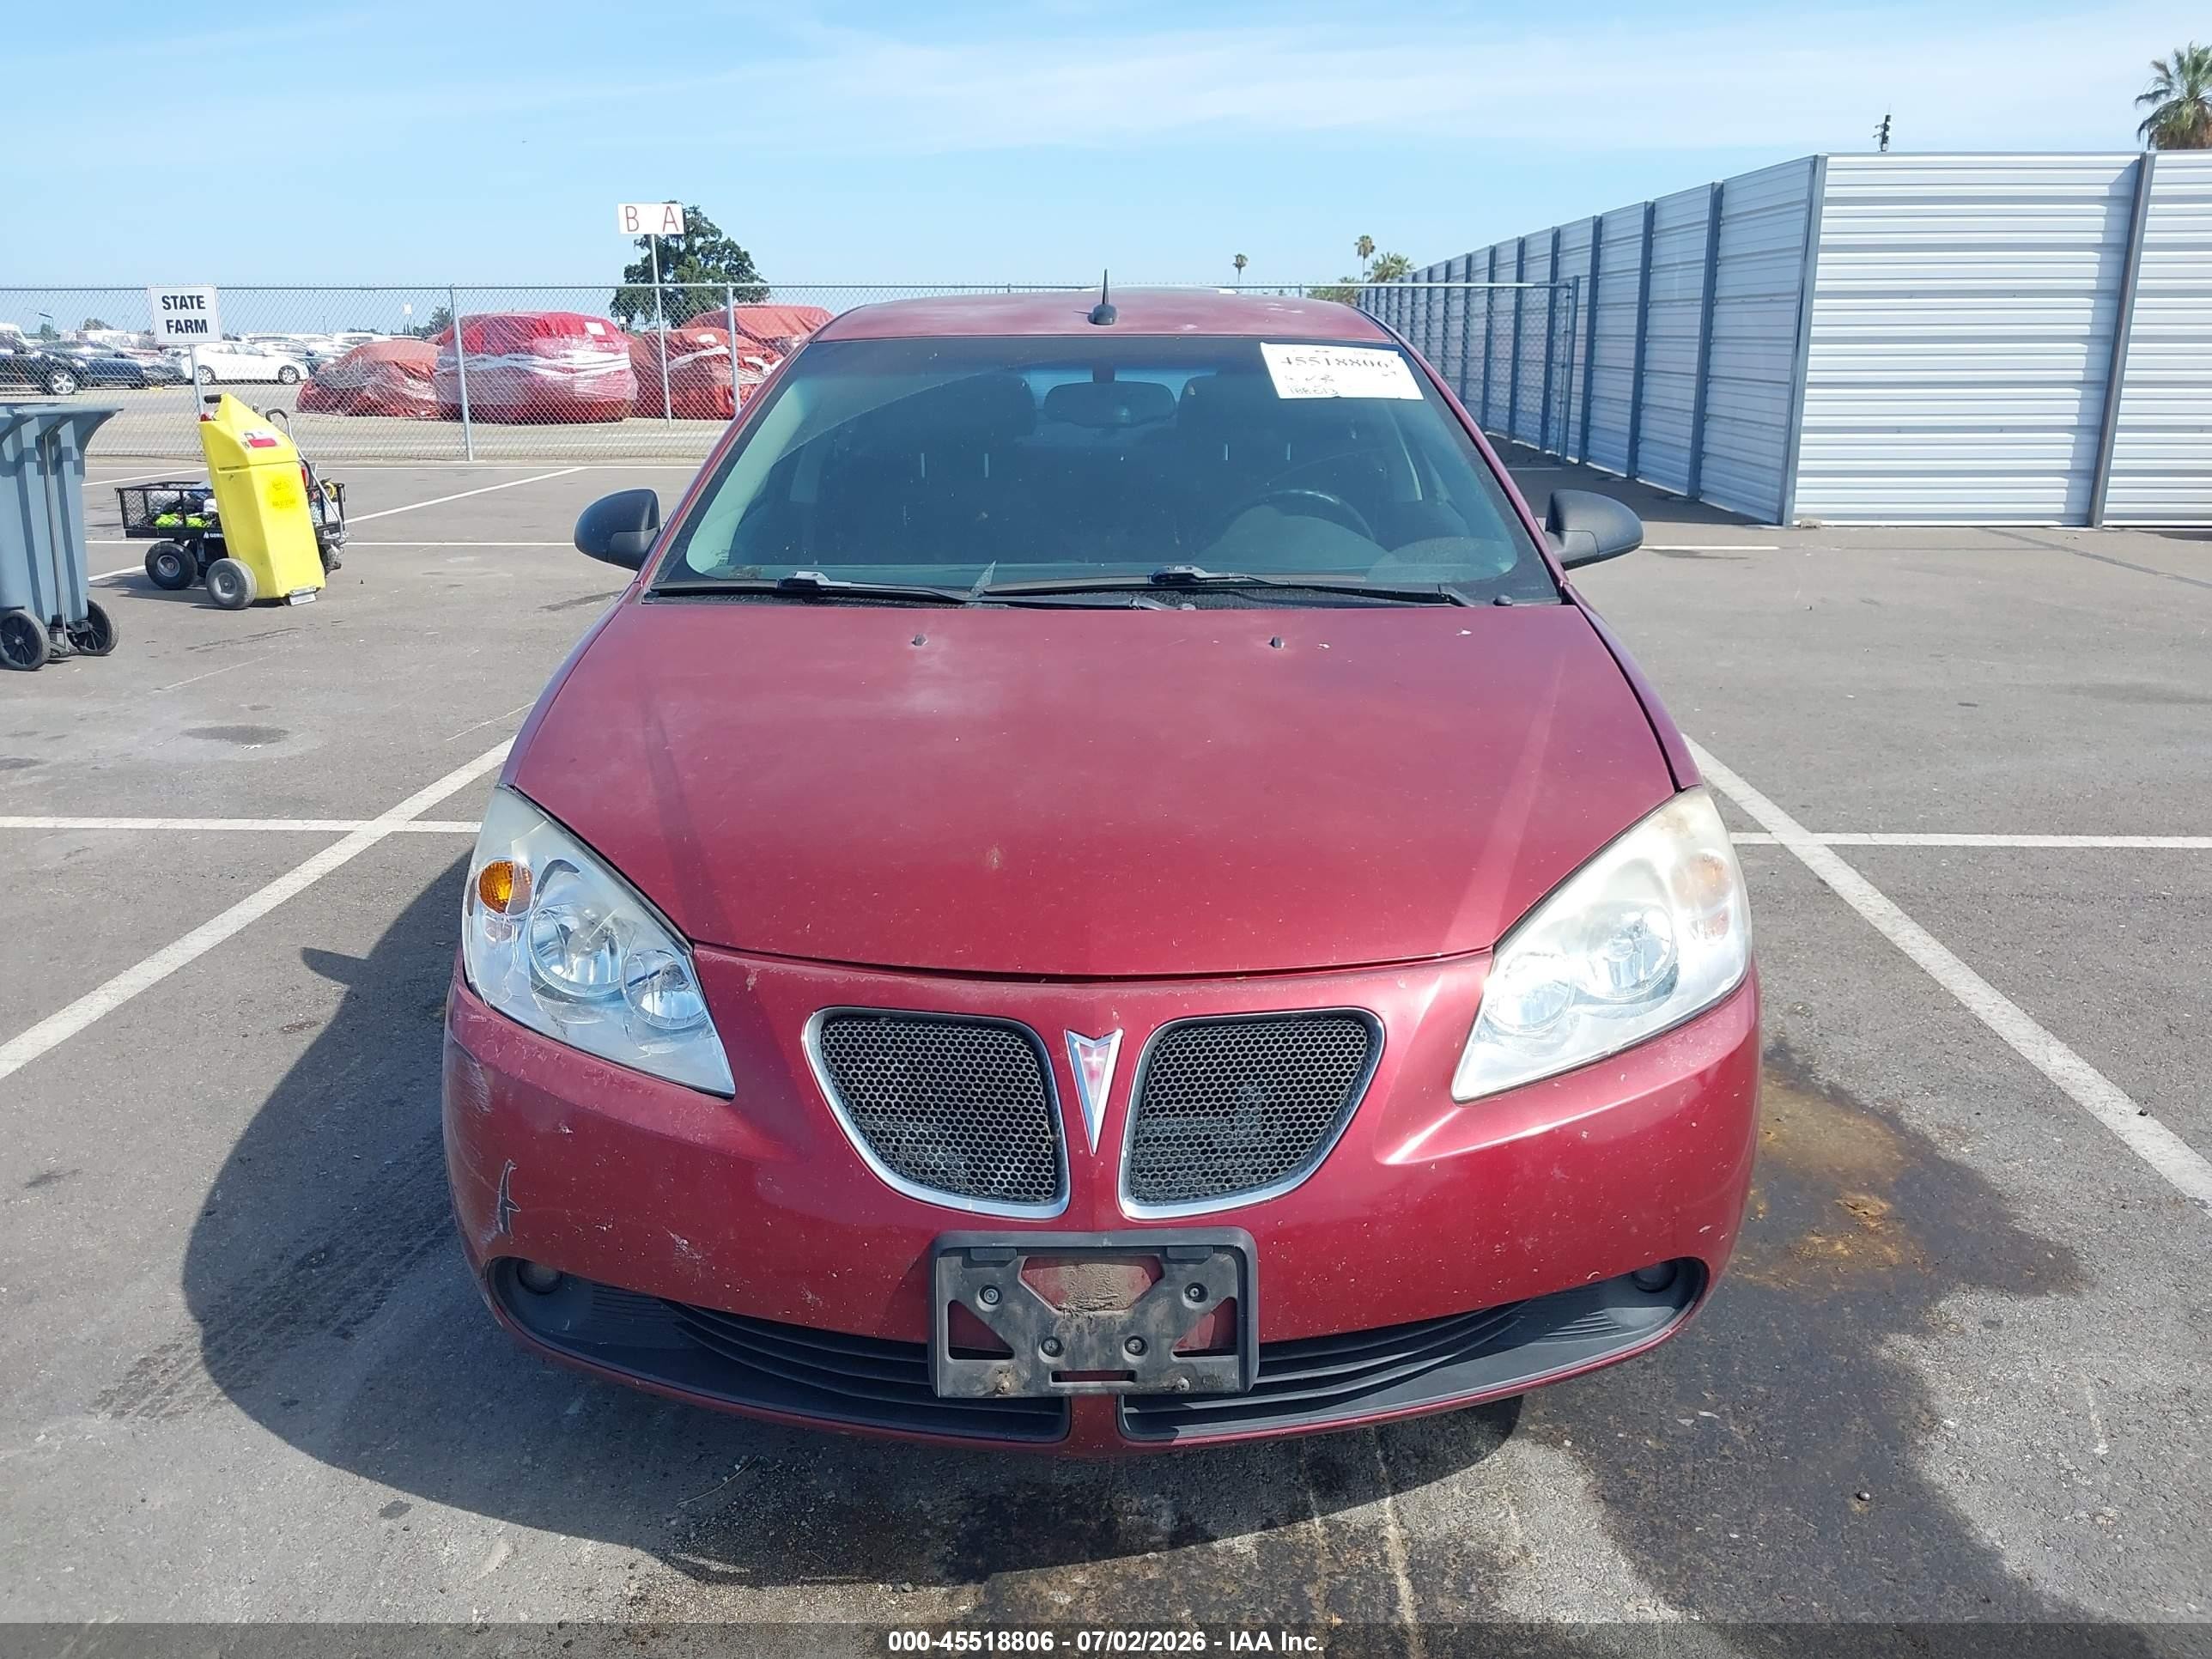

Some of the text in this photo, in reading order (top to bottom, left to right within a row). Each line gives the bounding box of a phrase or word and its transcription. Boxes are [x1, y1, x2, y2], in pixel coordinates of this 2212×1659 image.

[625, 205, 680, 233] B A
[161, 295, 207, 310] STATE
[166, 319, 209, 334] FARM
